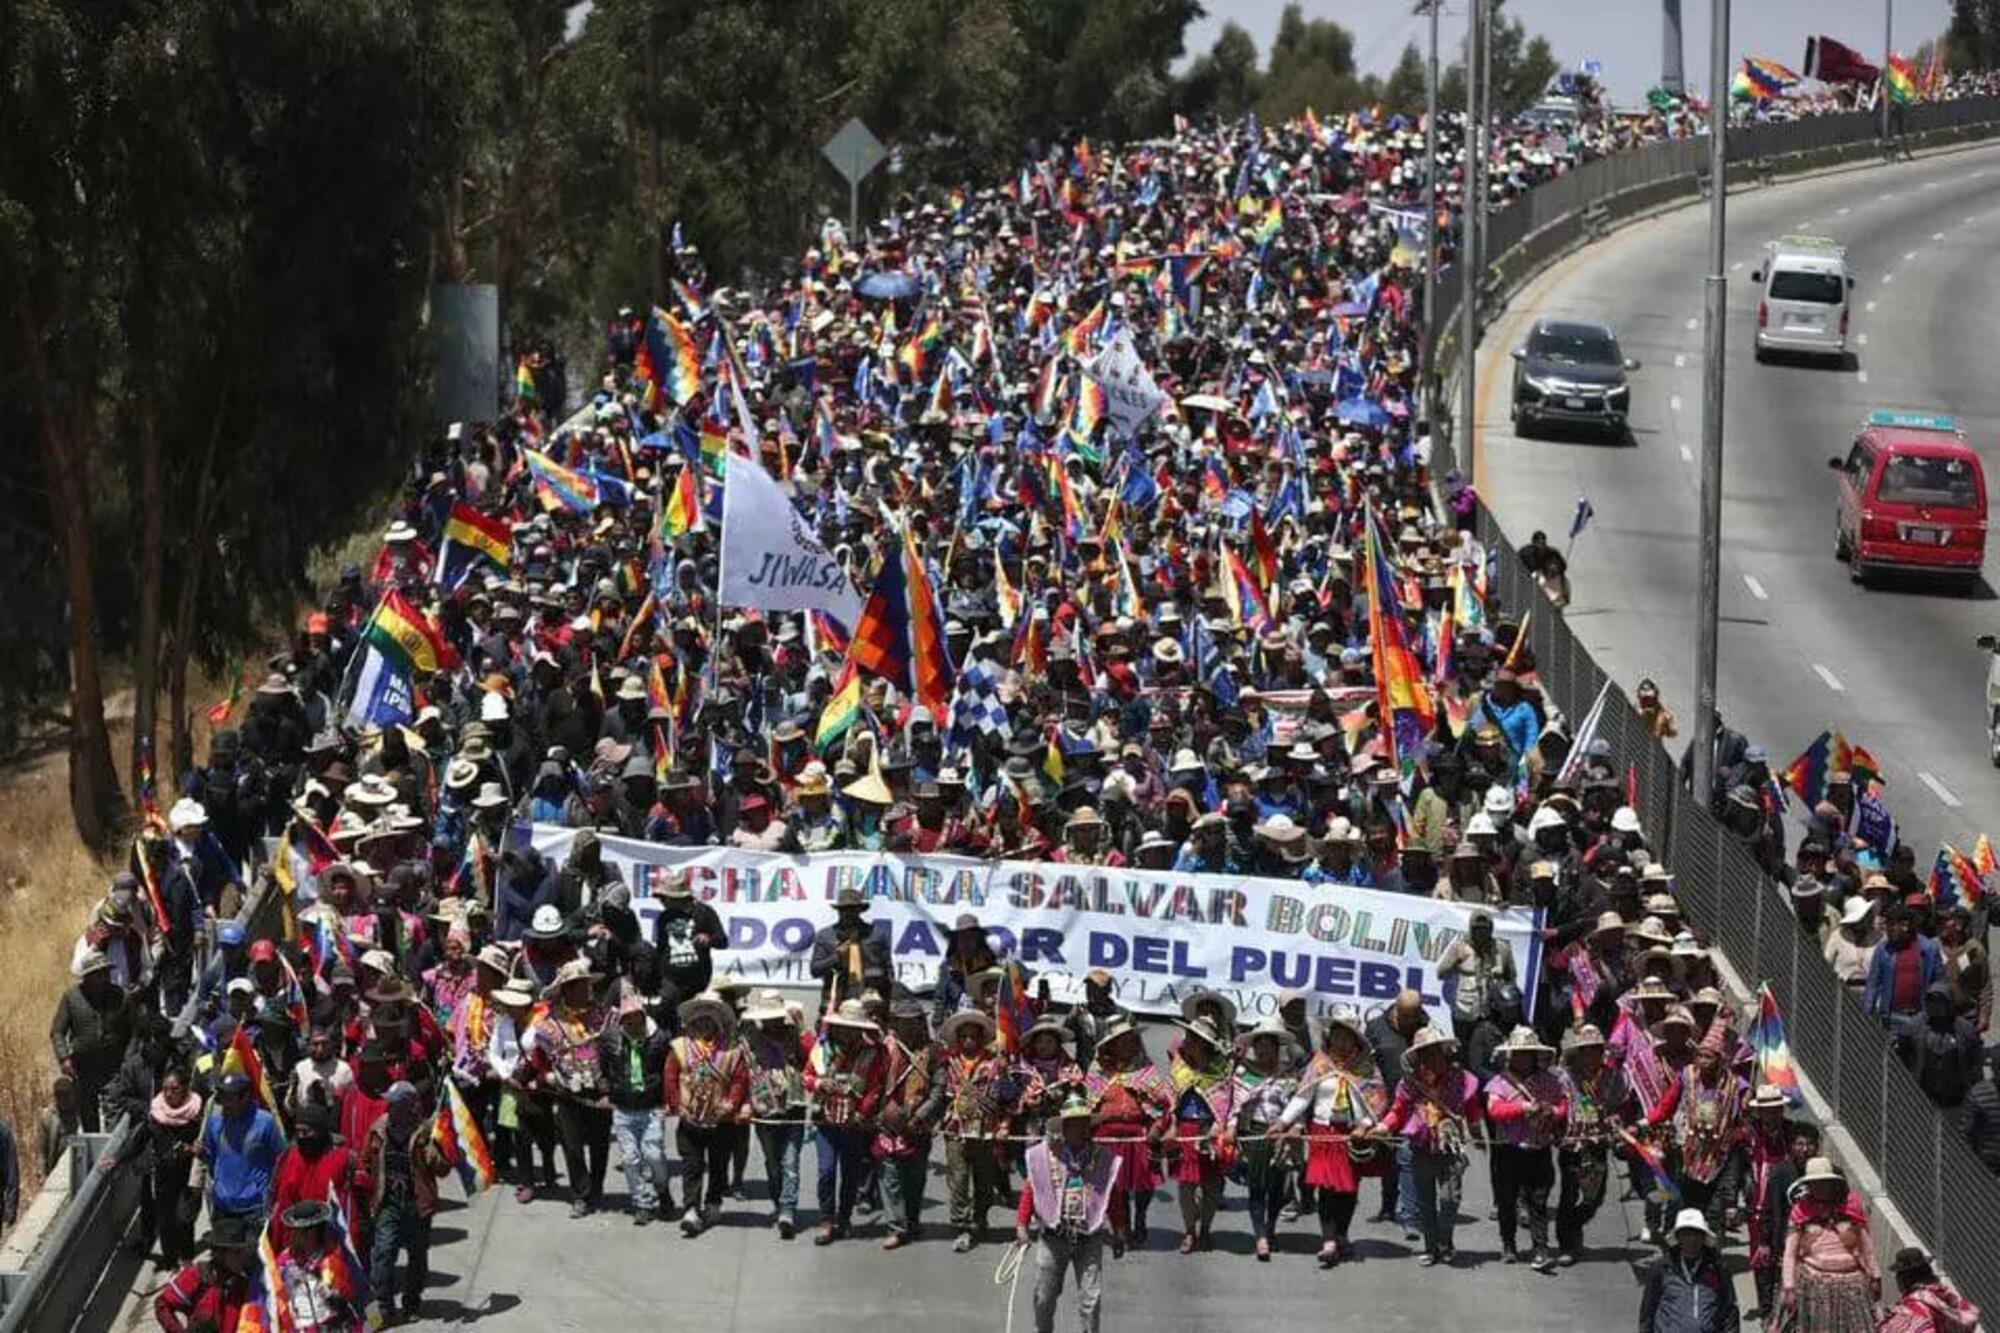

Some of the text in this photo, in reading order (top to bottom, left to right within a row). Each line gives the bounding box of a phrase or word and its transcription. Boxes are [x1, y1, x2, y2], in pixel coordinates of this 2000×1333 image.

[748, 551, 847, 596] JIWASA
[825, 864, 987, 907] PARA
[1007, 872, 1248, 927] SALVAR
[1266, 894, 1464, 963] BOLIV
[1088, 931, 1207, 979] DEL
[1231, 946, 1457, 1007] PUEBL
